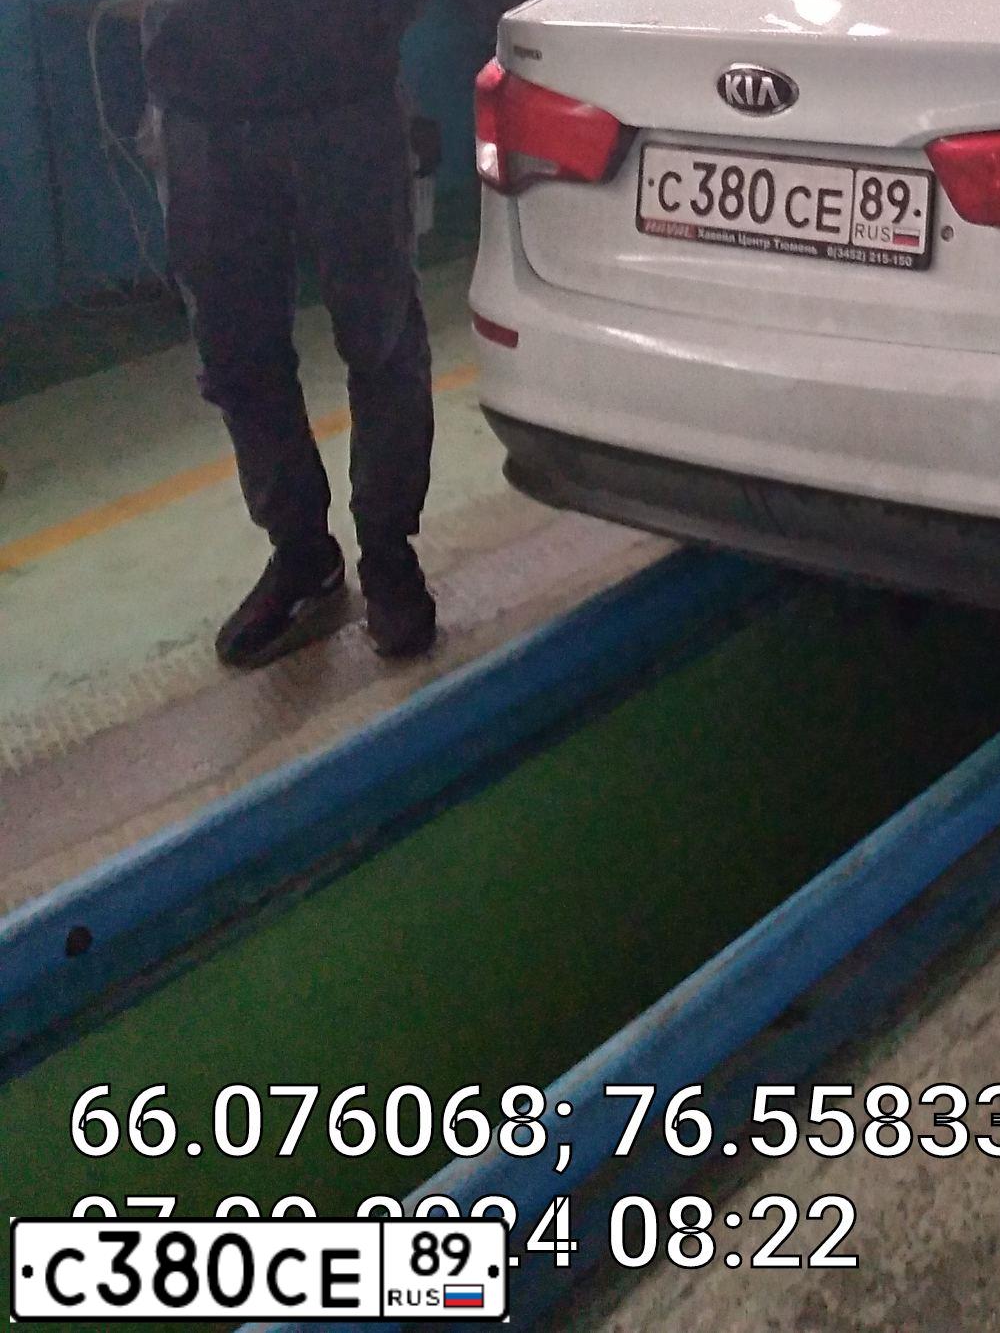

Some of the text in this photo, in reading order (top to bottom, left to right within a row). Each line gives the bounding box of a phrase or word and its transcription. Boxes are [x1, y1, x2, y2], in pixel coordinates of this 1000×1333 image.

[724, 74, 781, 106] KIA
[657, 161, 911, 233] С380СЕ 89
[855, 221, 891, 243] RUS
